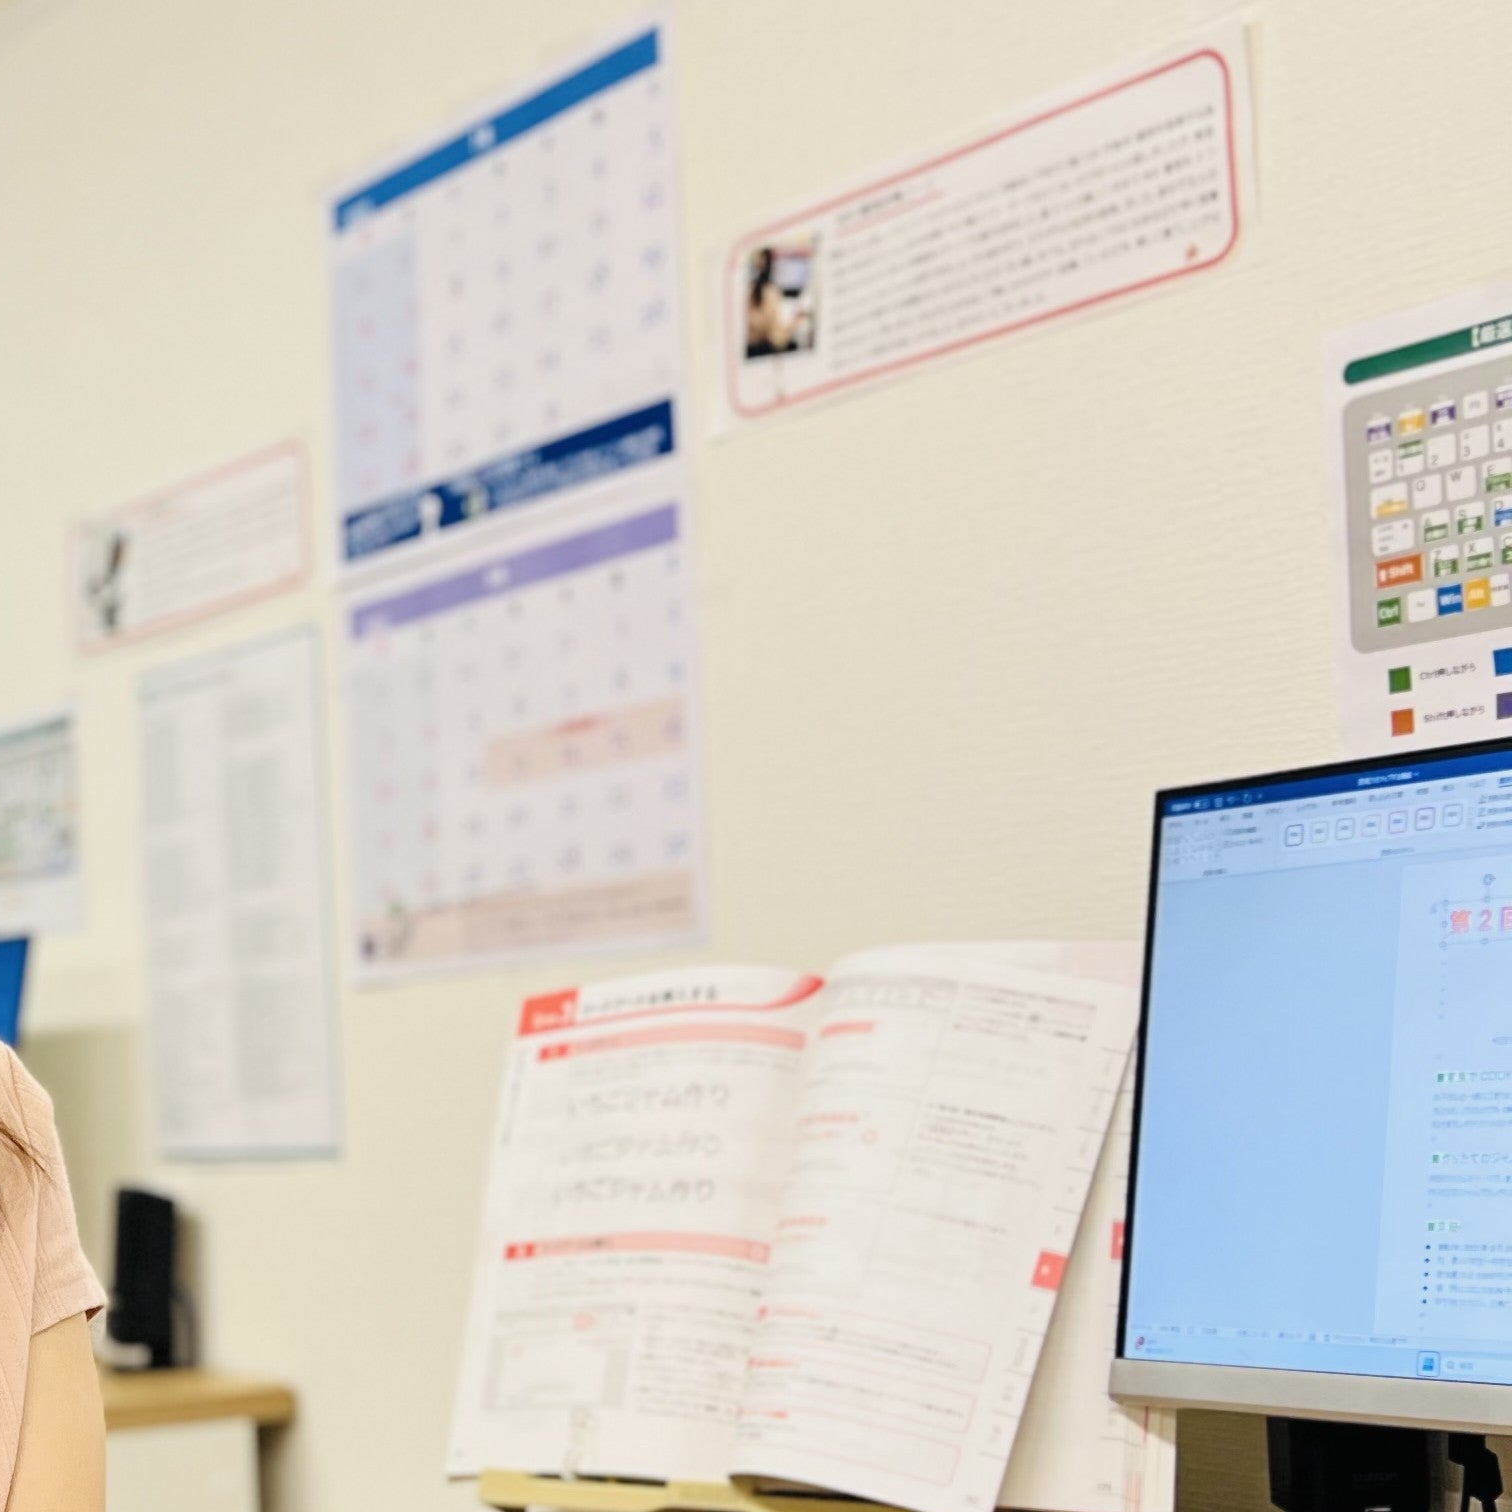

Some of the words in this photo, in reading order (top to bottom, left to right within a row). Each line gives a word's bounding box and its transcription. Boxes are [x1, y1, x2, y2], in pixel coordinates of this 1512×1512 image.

[1388, 562, 1415, 579] Shift
[1439, 593, 1462, 606] Win
[1379, 606, 1399, 620] Ctrl
